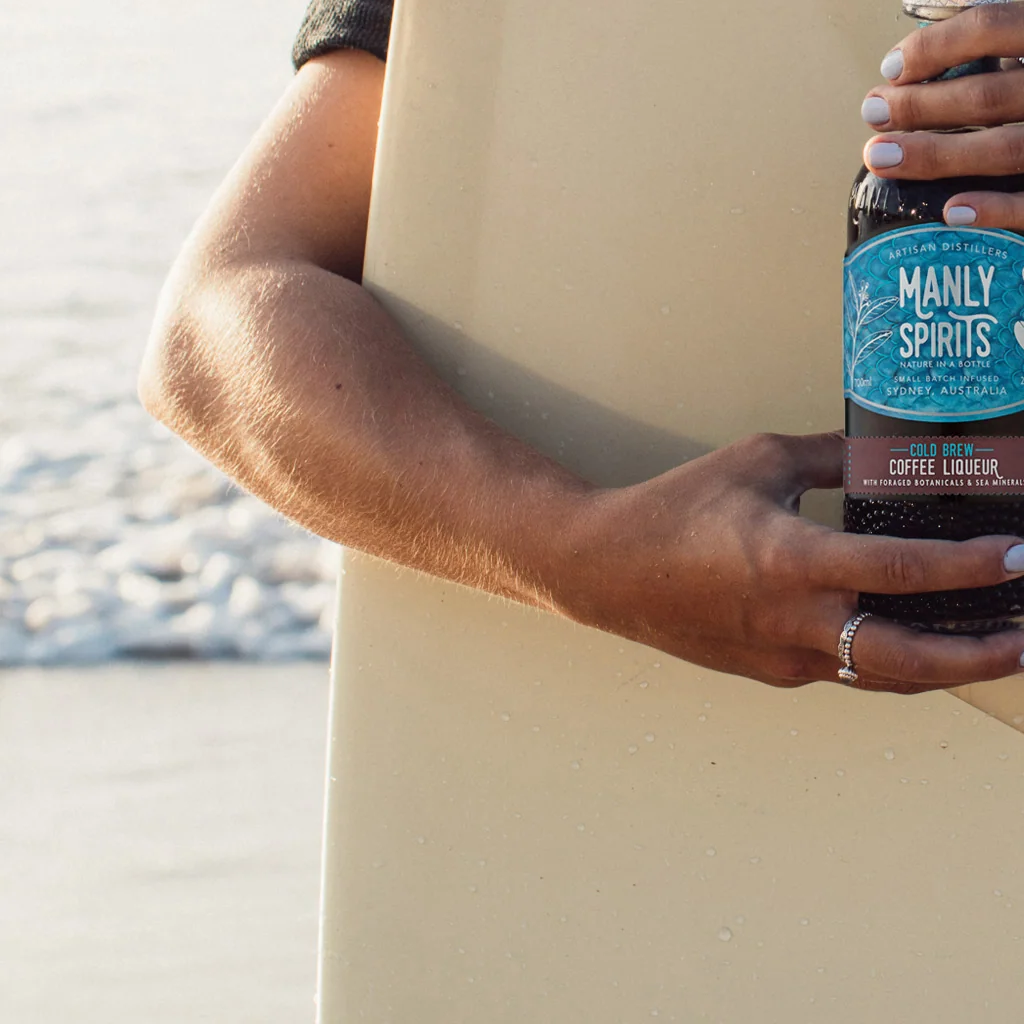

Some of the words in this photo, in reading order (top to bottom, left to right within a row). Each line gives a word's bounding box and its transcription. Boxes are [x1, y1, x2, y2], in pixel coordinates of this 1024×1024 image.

[888, 243, 937, 260] ARTISAN
[942, 242, 1008, 260] DISTILLERS
[899, 264, 995, 319] MANLY
[899, 311, 999, 359] SPIRITS
[900, 360, 934, 368] NATURE
[936, 360, 947, 368] IN
[948, 360, 956, 368] A
[958, 360, 991, 368] BOTTLE
[894, 375, 922, 383] SMALL
[925, 375, 956, 383] BATCH
[959, 375, 1000, 383] INFUSED
[886, 386, 935, 396] SYDNEY,
[940, 386, 1008, 396] AUSTRALIA
[909, 442, 938, 457] COLD
[942, 442, 975, 457] BREW
[889, 458, 936, 476] COFFEE
[943, 458, 1004, 480] LIQUEUR
[863, 478, 879, 487] WITH
[880, 478, 912, 487] FORAGED
[914, 478, 964, 487] BOTANICALS
[967, 478, 973, 487] &
[975, 478, 991, 487] SEA
